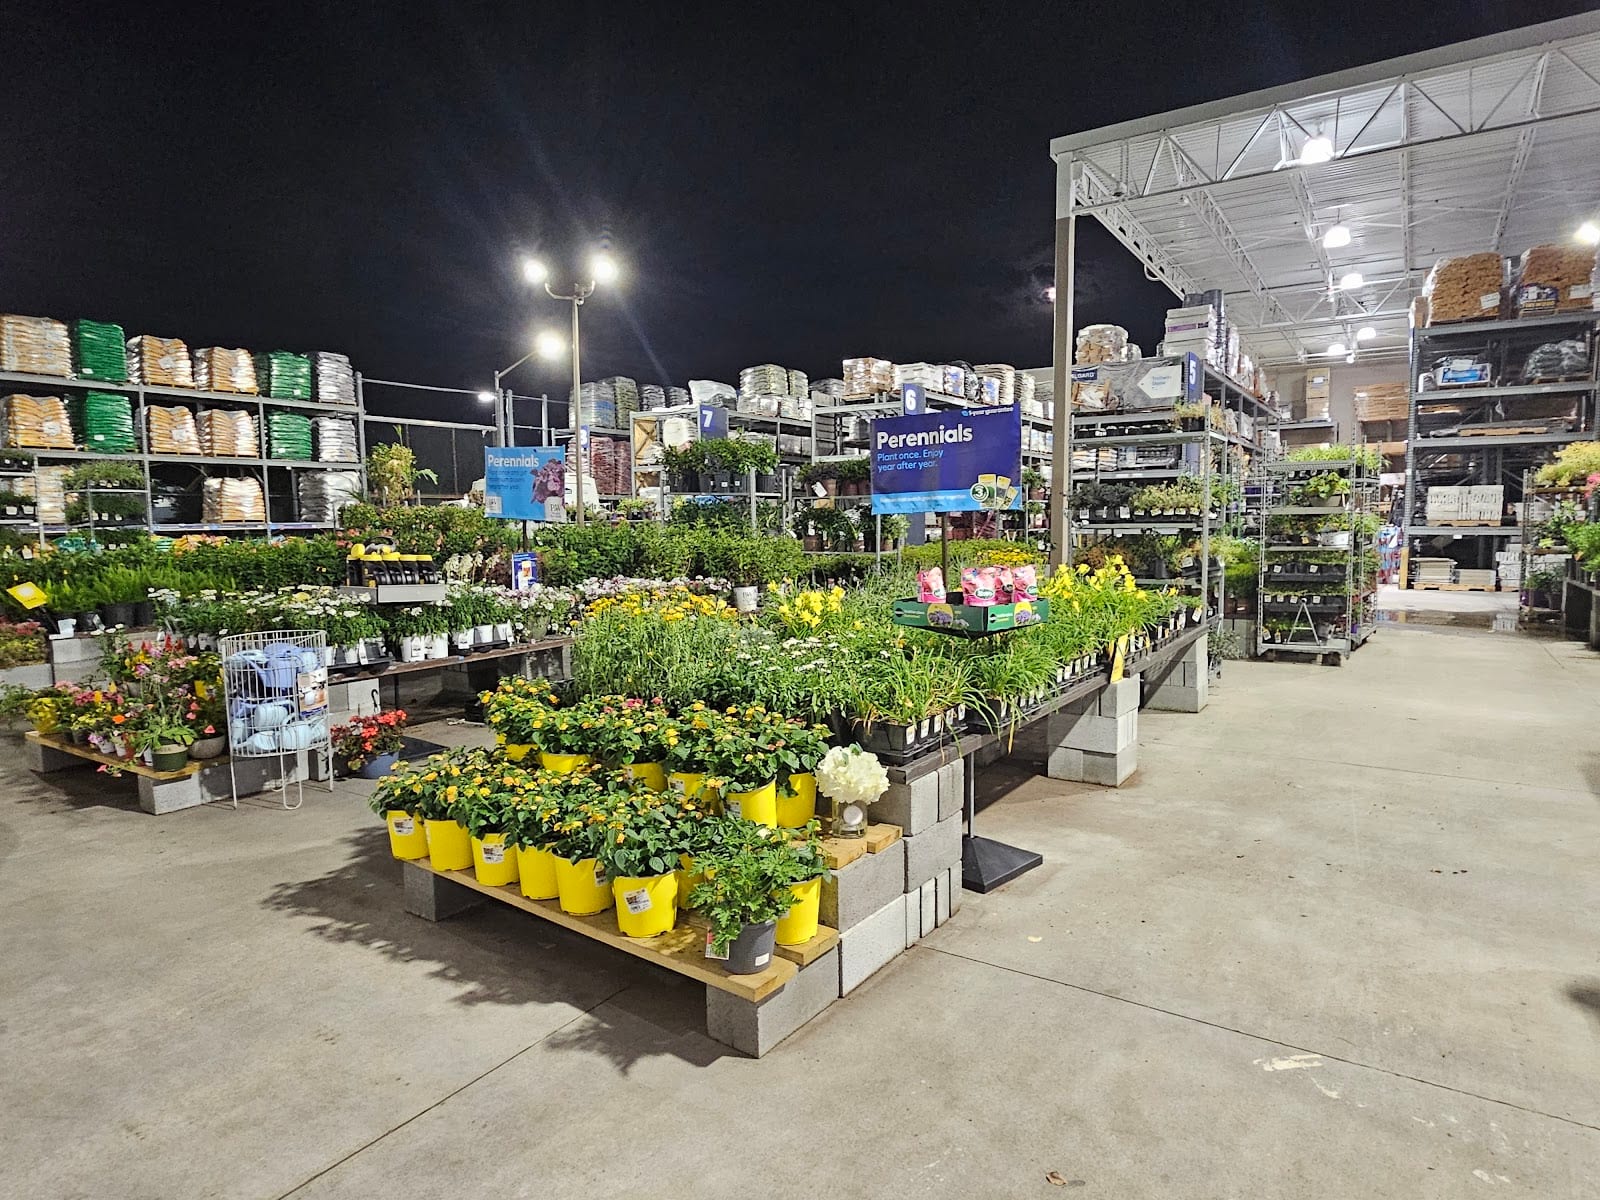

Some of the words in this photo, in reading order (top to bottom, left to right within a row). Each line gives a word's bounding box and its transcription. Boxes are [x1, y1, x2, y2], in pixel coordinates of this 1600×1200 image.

[1189, 359, 1197, 385] 5
[905, 389, 917, 411] 6
[702, 410, 713, 427] 7
[877, 424, 972, 449] Perennials
[487, 454, 540, 467] Perennials
[877, 452, 898, 462] Plant
[899, 452, 922, 460] once.
[923, 449, 944, 459] Enjoy
[877, 464, 896, 473] year
[896, 462, 917, 471] after
[975, 488, 984, 498] 3
